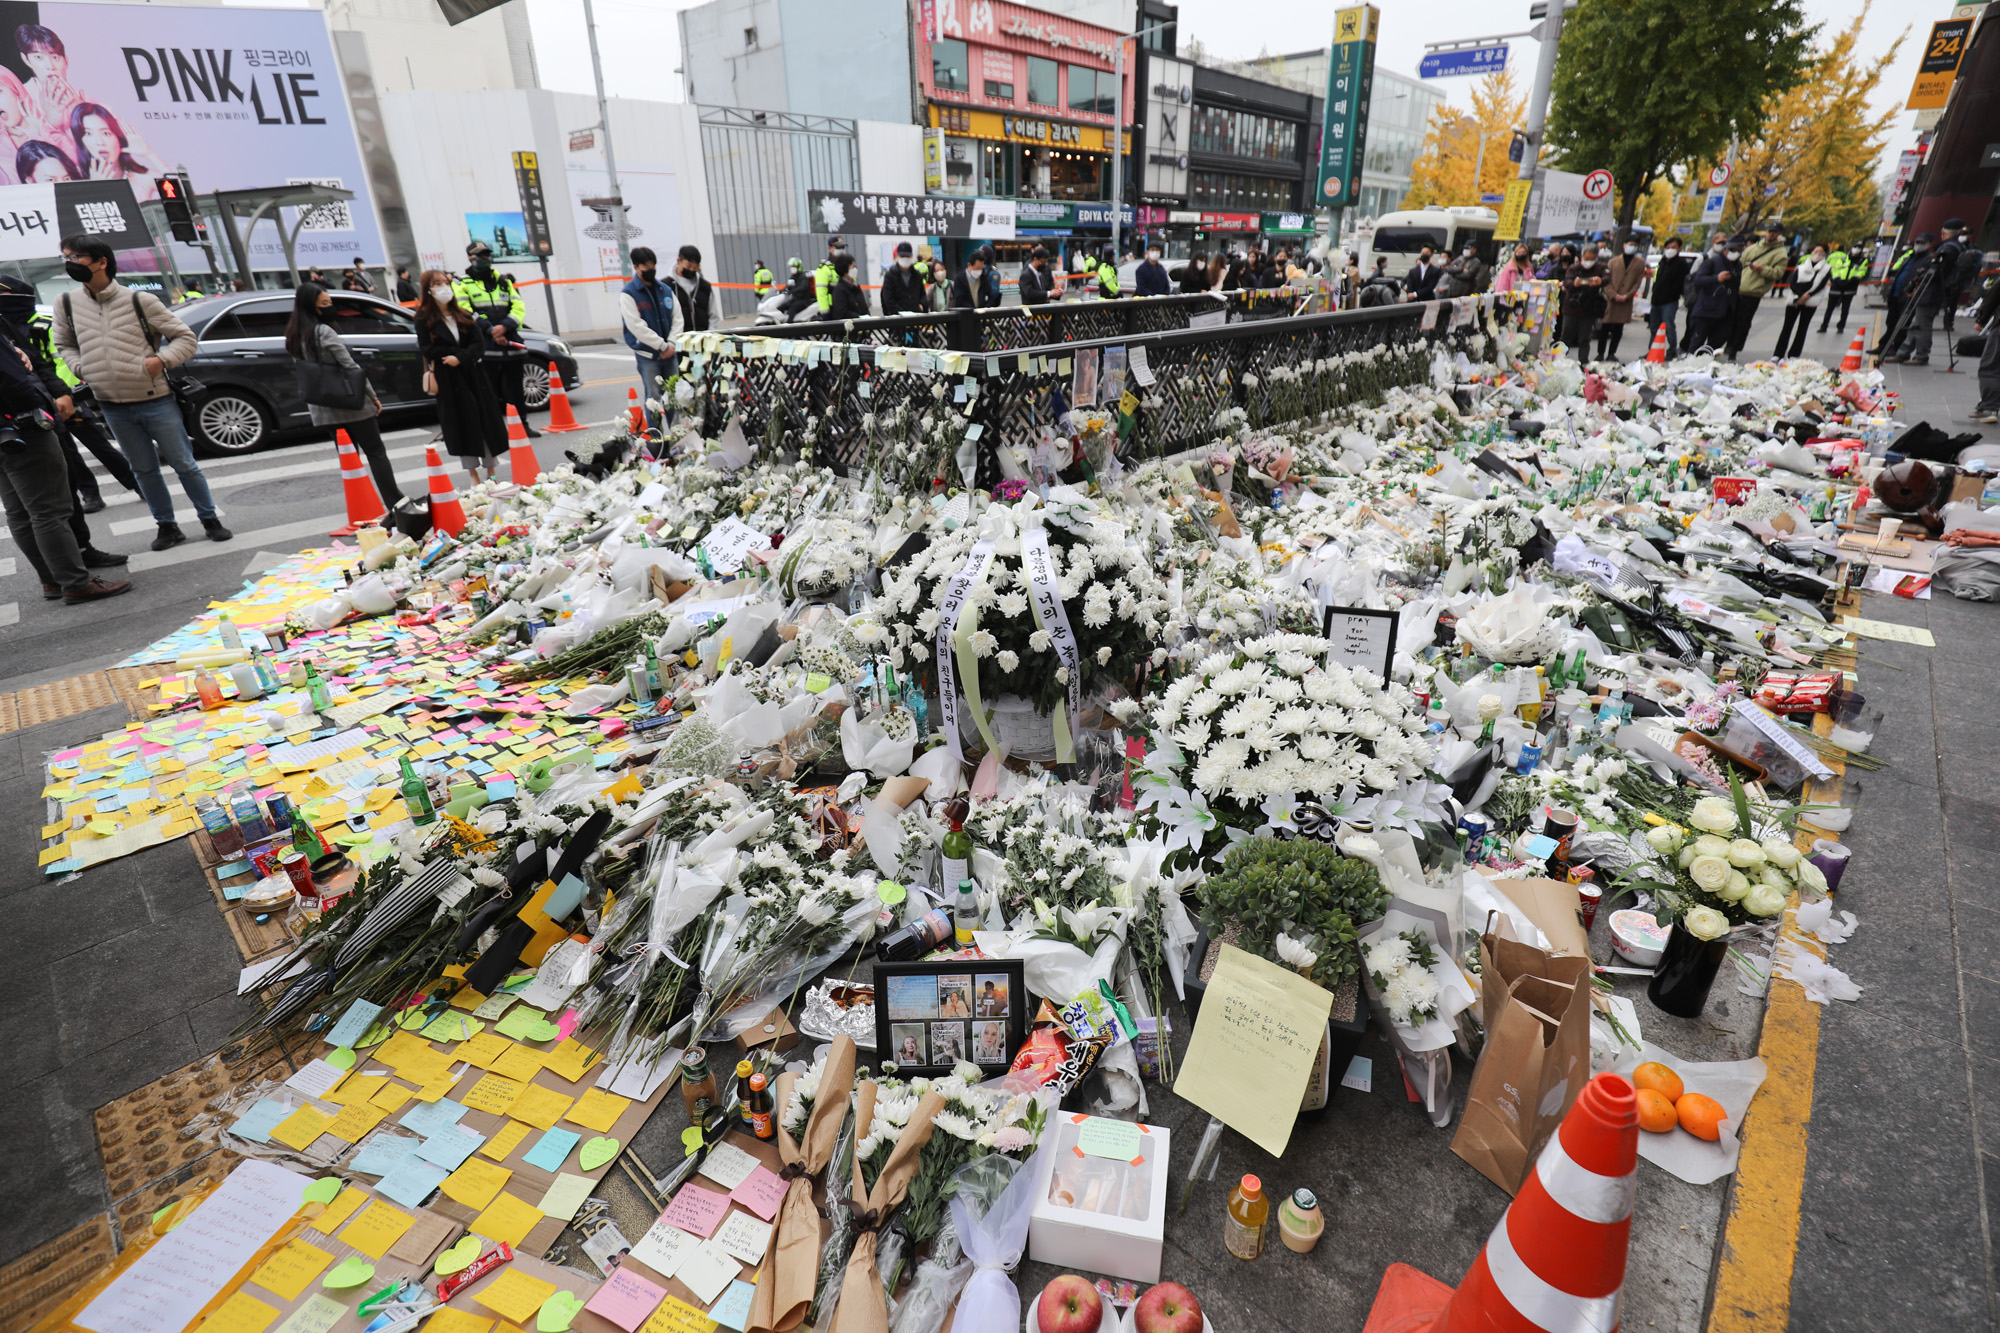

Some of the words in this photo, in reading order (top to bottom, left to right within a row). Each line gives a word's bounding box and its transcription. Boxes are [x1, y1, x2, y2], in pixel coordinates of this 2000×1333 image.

[1936, 28, 1964, 39] emart
[1343, 44, 1349, 62] 1
[1472, 49, 1504, 62] 보광로
[1930, 37, 1960, 57] 24
[244, 49, 312, 67] 핑크라이
[120, 47, 245, 105] PINK
[250, 73, 327, 124] LIE
[1332, 76, 1348, 139] 이태원
[1015, 118, 1047, 140] 이바돔
[1051, 122, 1081, 143] 감자탕
[75, 201, 122, 219] 더불어
[853, 195, 890, 214] 이태원
[895, 197, 919, 216] 참사
[923, 197, 966, 218] 희생자의
[1078, 209, 1102, 222] EDIYA
[81, 216, 128, 235] 민주당
[875, 216, 911, 235] 명복을
[915, 217, 949, 235] 빕니다
[945, 577, 973, 612] 찾으러
[1038, 591, 1058, 620] 너의
[1052, 626, 1067, 640] 손
[1063, 1001, 1096, 1039] 청포
